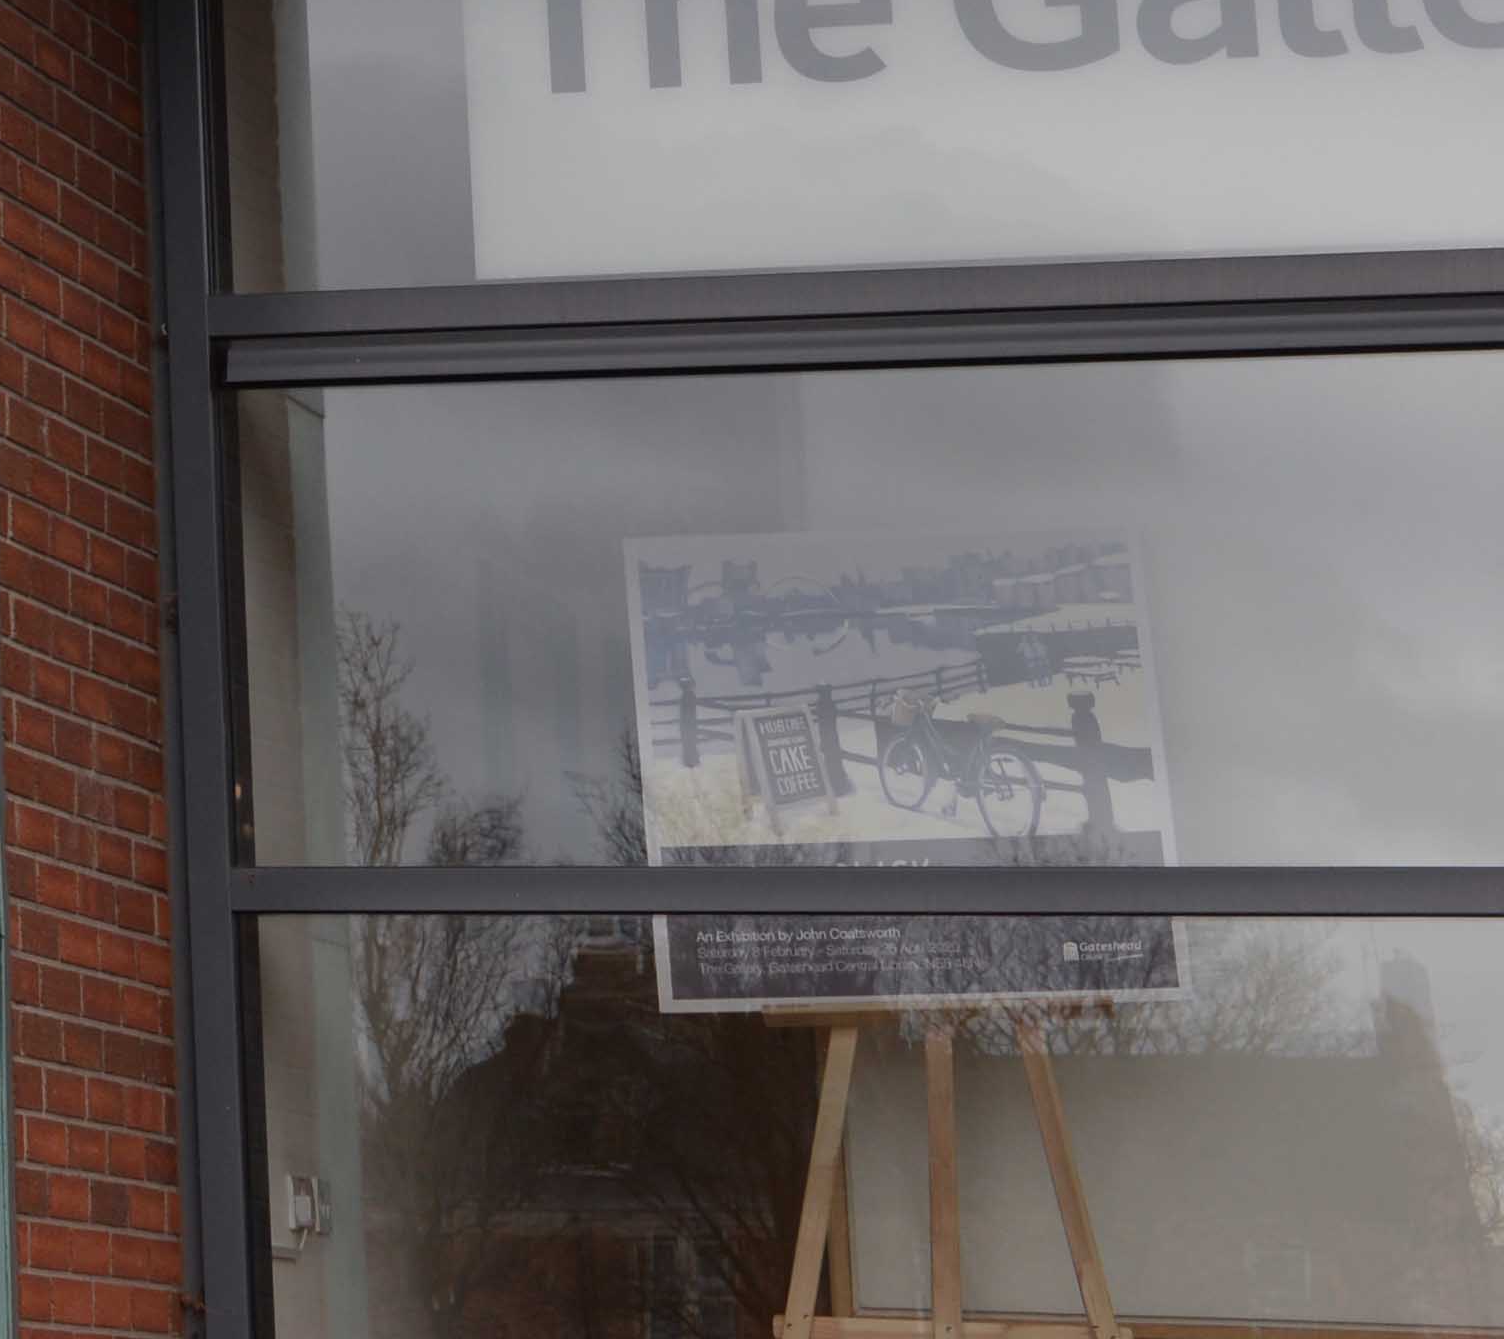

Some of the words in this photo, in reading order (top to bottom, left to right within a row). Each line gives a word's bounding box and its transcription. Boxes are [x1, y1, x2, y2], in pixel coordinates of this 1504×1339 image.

[696, 930, 713, 943] An
[716, 929, 775, 943] Exhibition
[778, 929, 793, 944] by
[796, 926, 826, 941] John
[829, 925, 901, 941] Coatsworth
[1079, 939, 1142, 952] Gateshead
